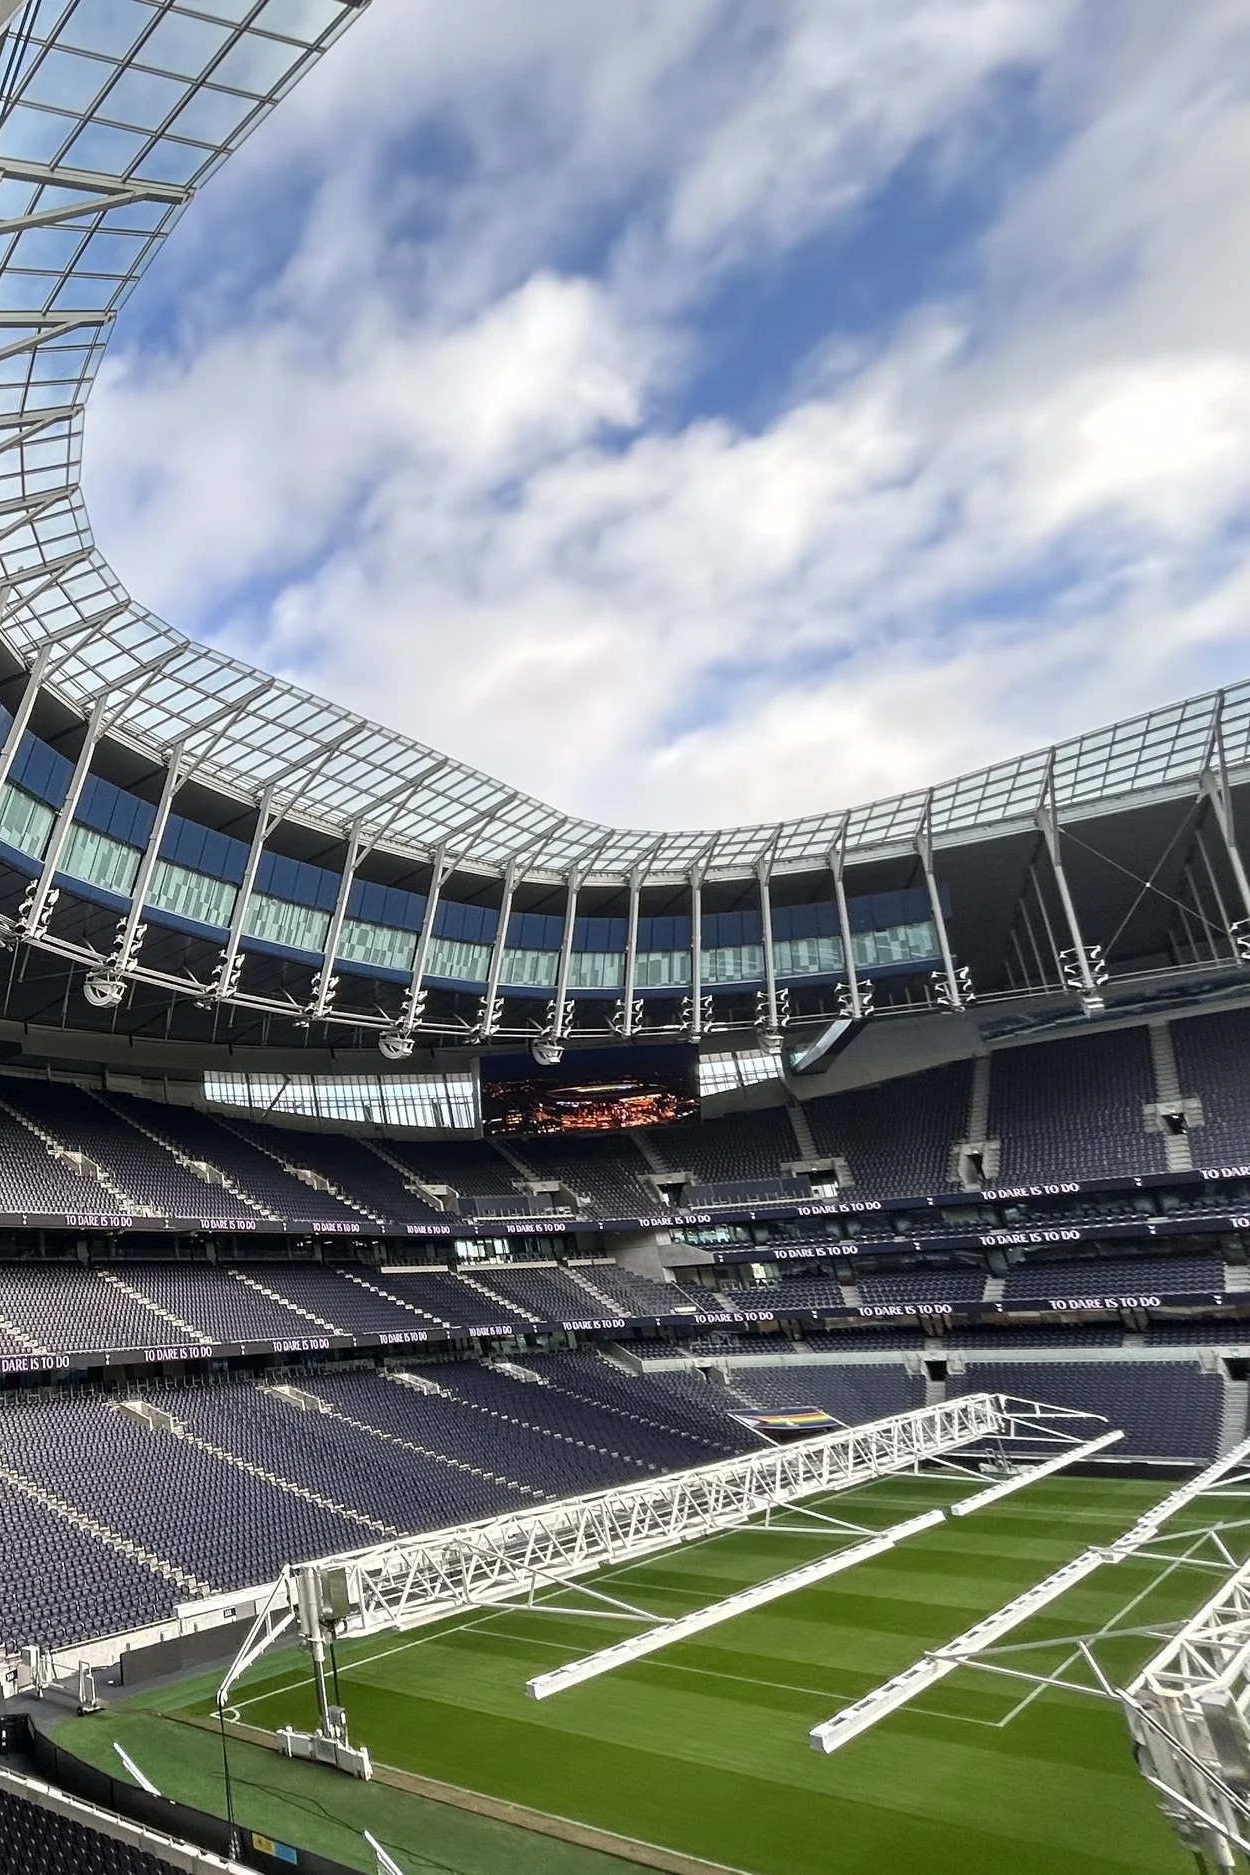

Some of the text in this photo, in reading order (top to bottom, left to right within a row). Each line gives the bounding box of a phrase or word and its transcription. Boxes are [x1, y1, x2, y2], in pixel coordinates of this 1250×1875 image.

[1201, 1166, 1250, 1179] TO DAR
[981, 1182, 1079, 1200] TO DARE IS TO DO
[797, 1201, 881, 1215] TO DARE IS TO DO
[65, 1215, 132, 1227] TO DARE IS TO DO
[200, 1220, 256, 1230] TO DARE IS TO DO
[638, 1219, 650, 1227] TO
[651, 1217, 673, 1226] DARE
[697, 1215, 711, 1223] DO
[1230, 1217, 1250, 1228] TO
[506, 1225, 515, 1233] TO
[536, 1224, 543, 1232] IS
[554, 1223, 566, 1231] DO
[979, 1230, 1080, 1245] TO DARE IS TO DO
[773, 1245, 858, 1259] TO DARE IS TO DO
[1049, 1296, 1160, 1310] TO DARE IS TO DO
[858, 1304, 952, 1316] TO DARE IS TO DO
[694, 1311, 774, 1323] TO DARE IS TO DO
[562, 1319, 625, 1330] TO DARE IS TO DO
[273, 1338, 329, 1352] TO DARE IS TO DO
[144, 1346, 212, 1361] TO DARE IS TO DO
[2, 1358, 28, 1372] DARE
[30, 1358, 39, 1370] IS
[41, 1357, 53, 1369] TO
[56, 1355, 69, 1368] DO
